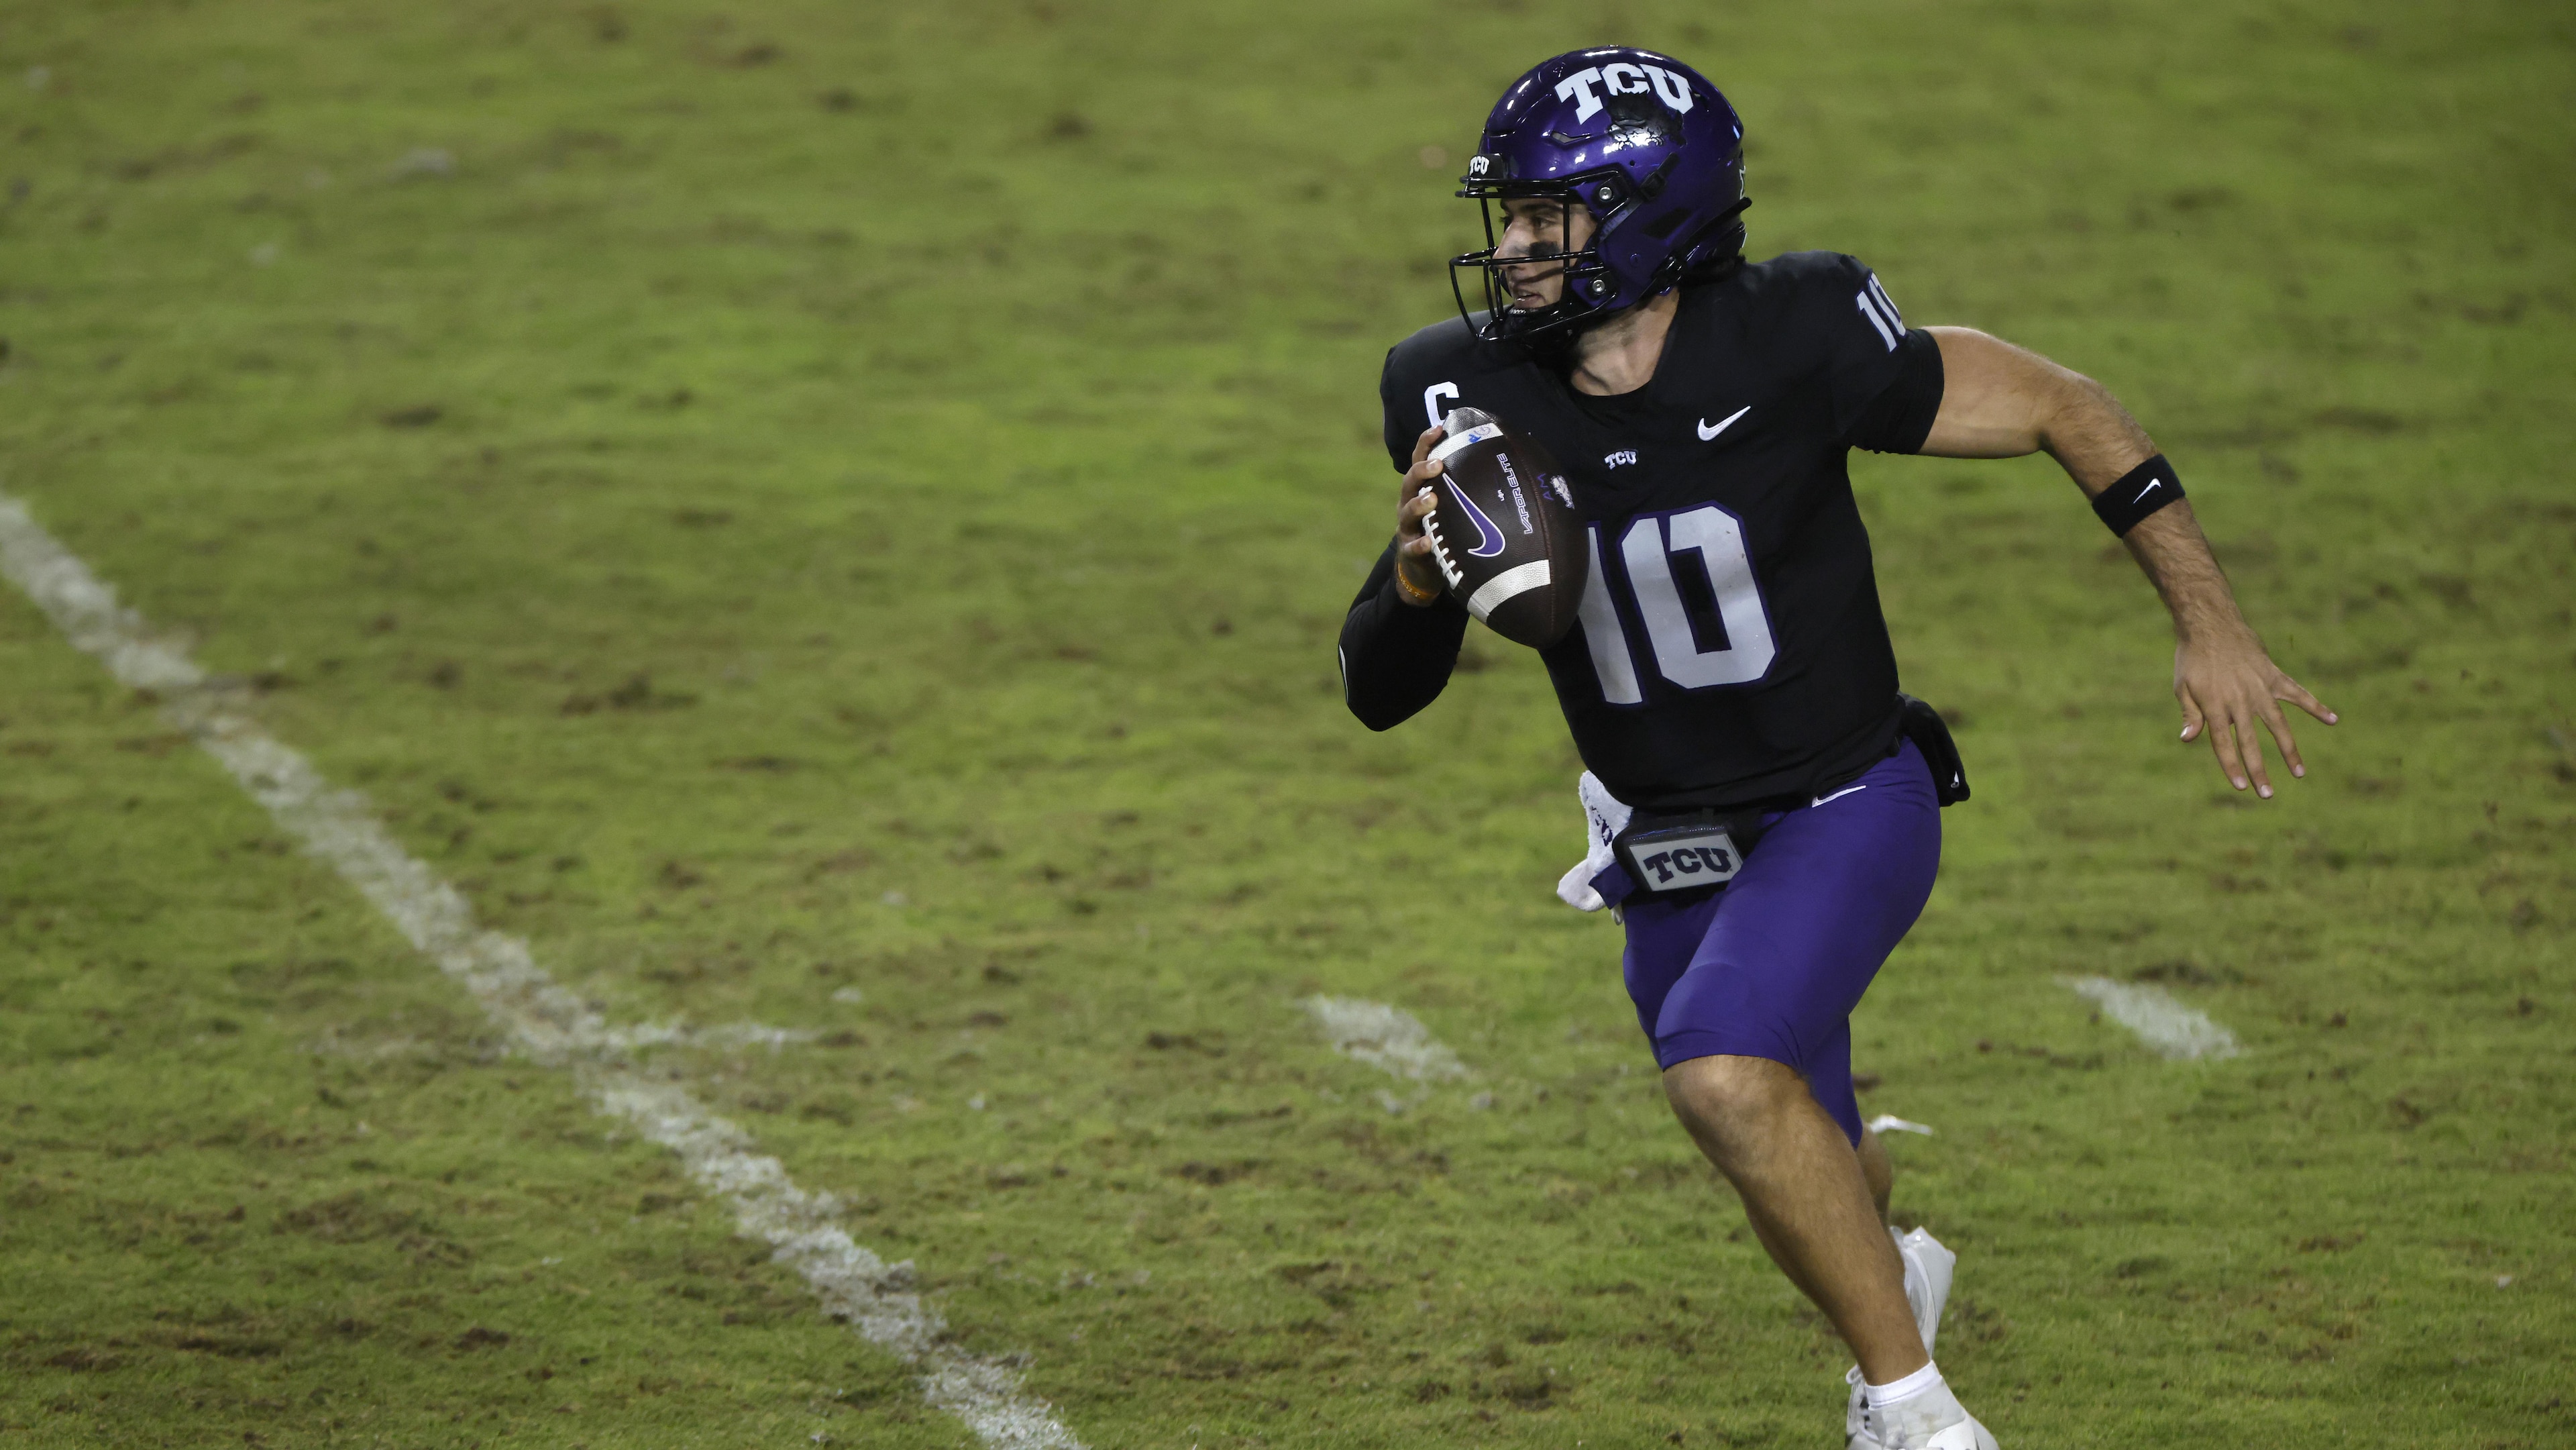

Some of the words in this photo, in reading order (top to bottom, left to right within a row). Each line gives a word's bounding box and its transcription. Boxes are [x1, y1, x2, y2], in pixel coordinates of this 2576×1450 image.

[1554, 62, 1694, 125] TCU
[1469, 156, 1489, 176] TCU
[1856, 272, 1907, 353] 10
[1424, 381, 1459, 427] C
[1604, 450, 1637, 470] TCU
[1643, 847, 1732, 884] TCU
